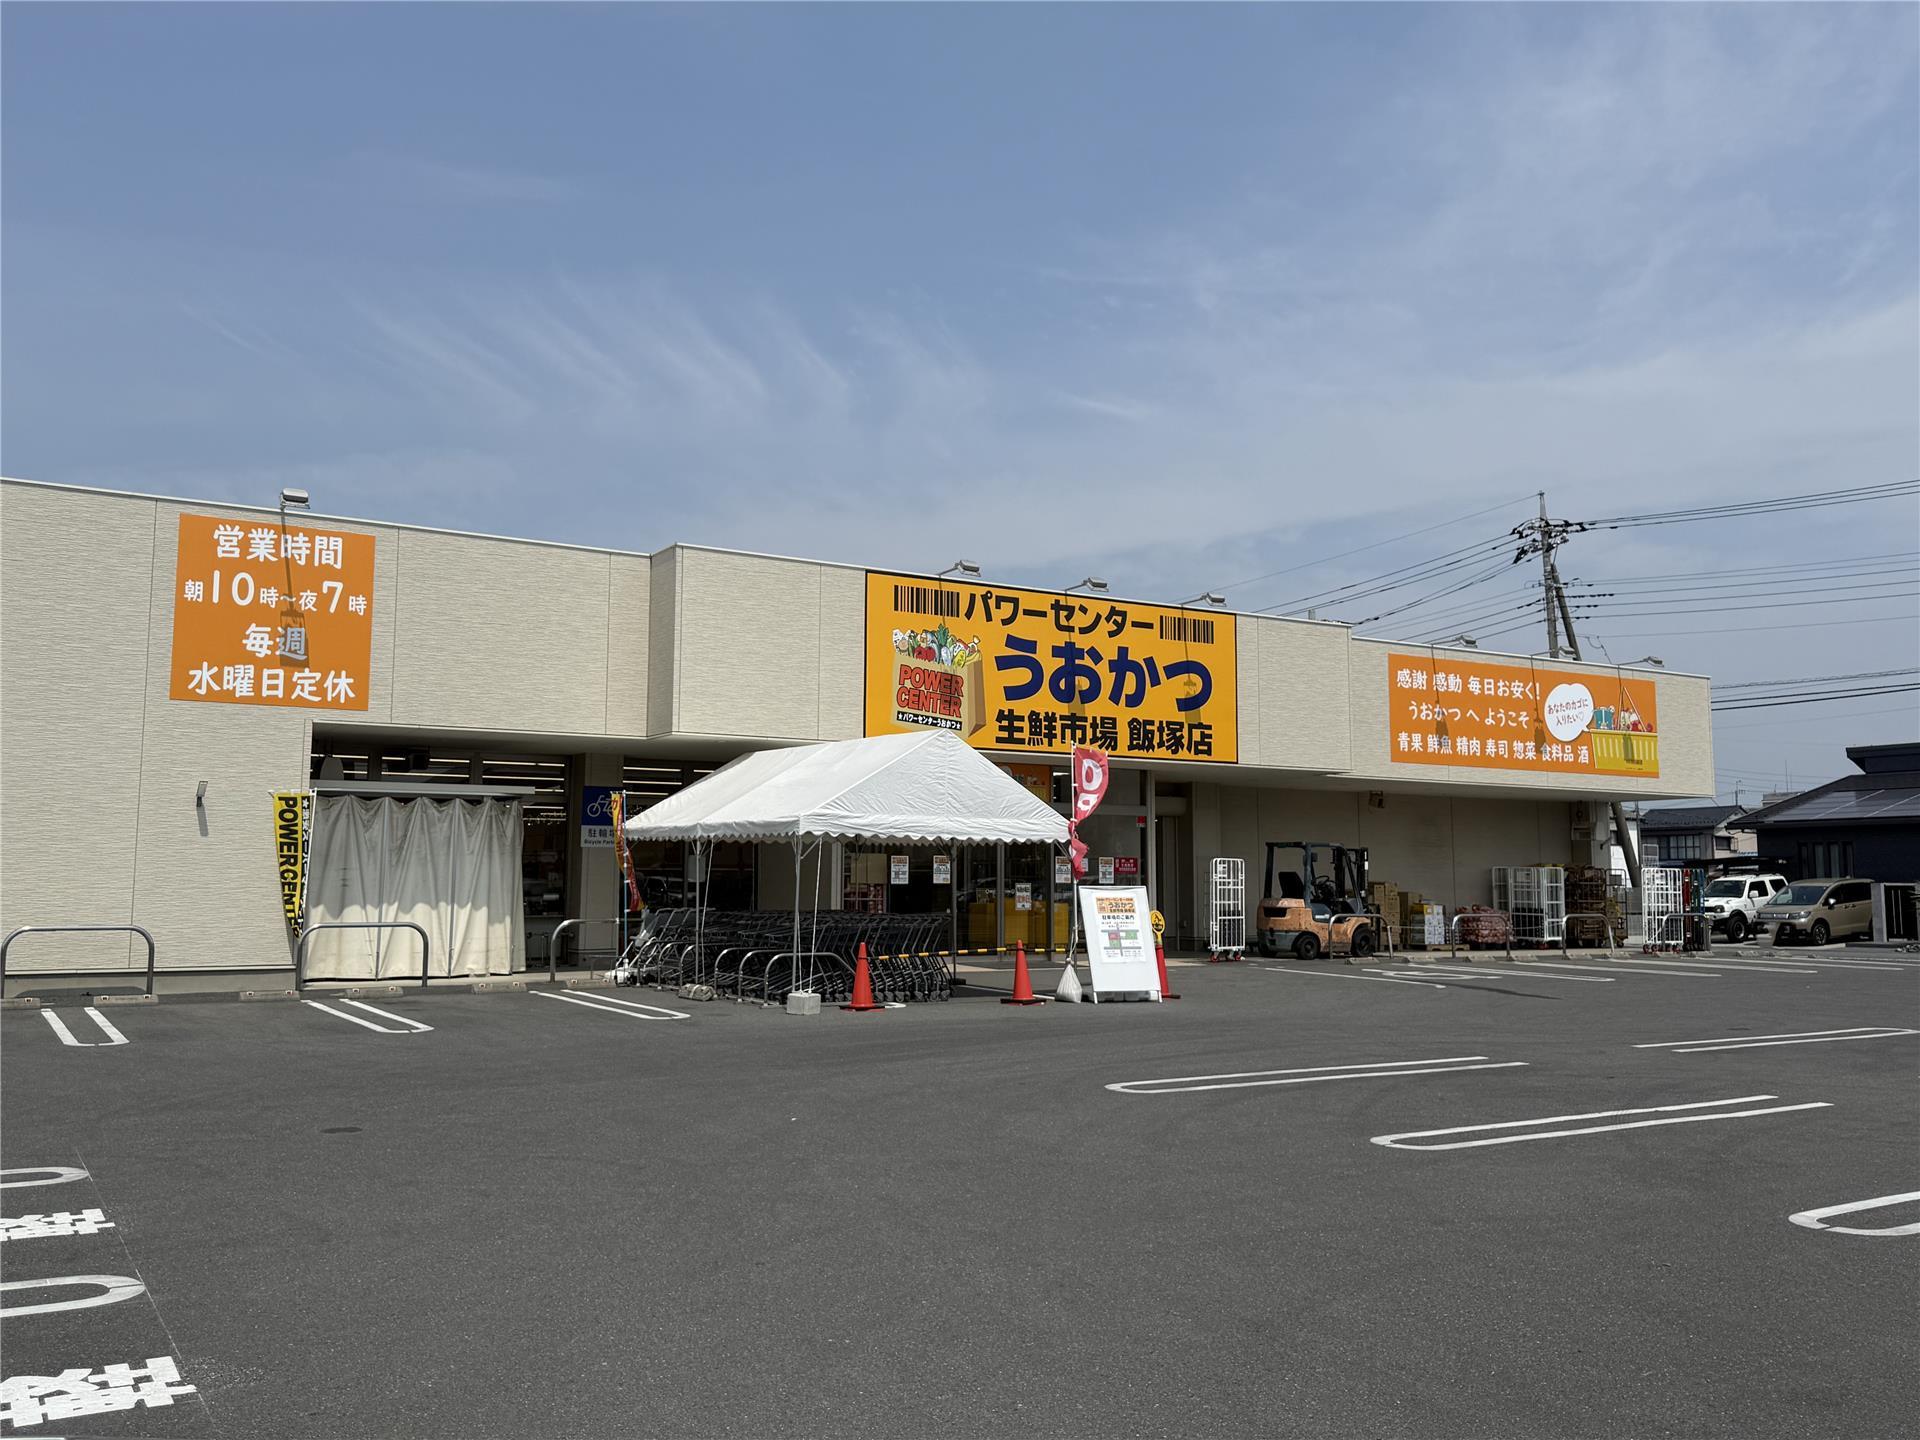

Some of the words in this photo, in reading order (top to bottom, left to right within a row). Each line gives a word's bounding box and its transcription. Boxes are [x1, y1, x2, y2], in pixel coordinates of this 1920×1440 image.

[213, 524, 343, 569] 営業時間
[964, 590, 1154, 638] パワーセンター
[242, 623, 308, 660] 毎週
[188, 661, 355, 703] 水曜日定休
[899, 664, 964, 697] POWER
[994, 634, 1212, 712] うおかつ
[1396, 669, 1427, 690] 感謝
[1433, 672, 1462, 693] 感動
[897, 686, 962, 718] CENTER
[1408, 701, 1461, 721] うおかつ
[1466, 709, 1480, 722] へ
[1484, 709, 1530, 728] ようこそ
[995, 708, 1118, 751] 生鮮市場
[1127, 720, 1213, 756] 飯塚店
[1397, 732, 1423, 753] 青果
[1427, 734, 1453, 754] 鮮魚
[1456, 735, 1481, 756] 精肉
[1485, 738, 1509, 758] 寿司
[1513, 740, 1536, 760] 惣菜
[1541, 742, 1574, 763] 食料品
[1578, 745, 1589, 764] 酒
